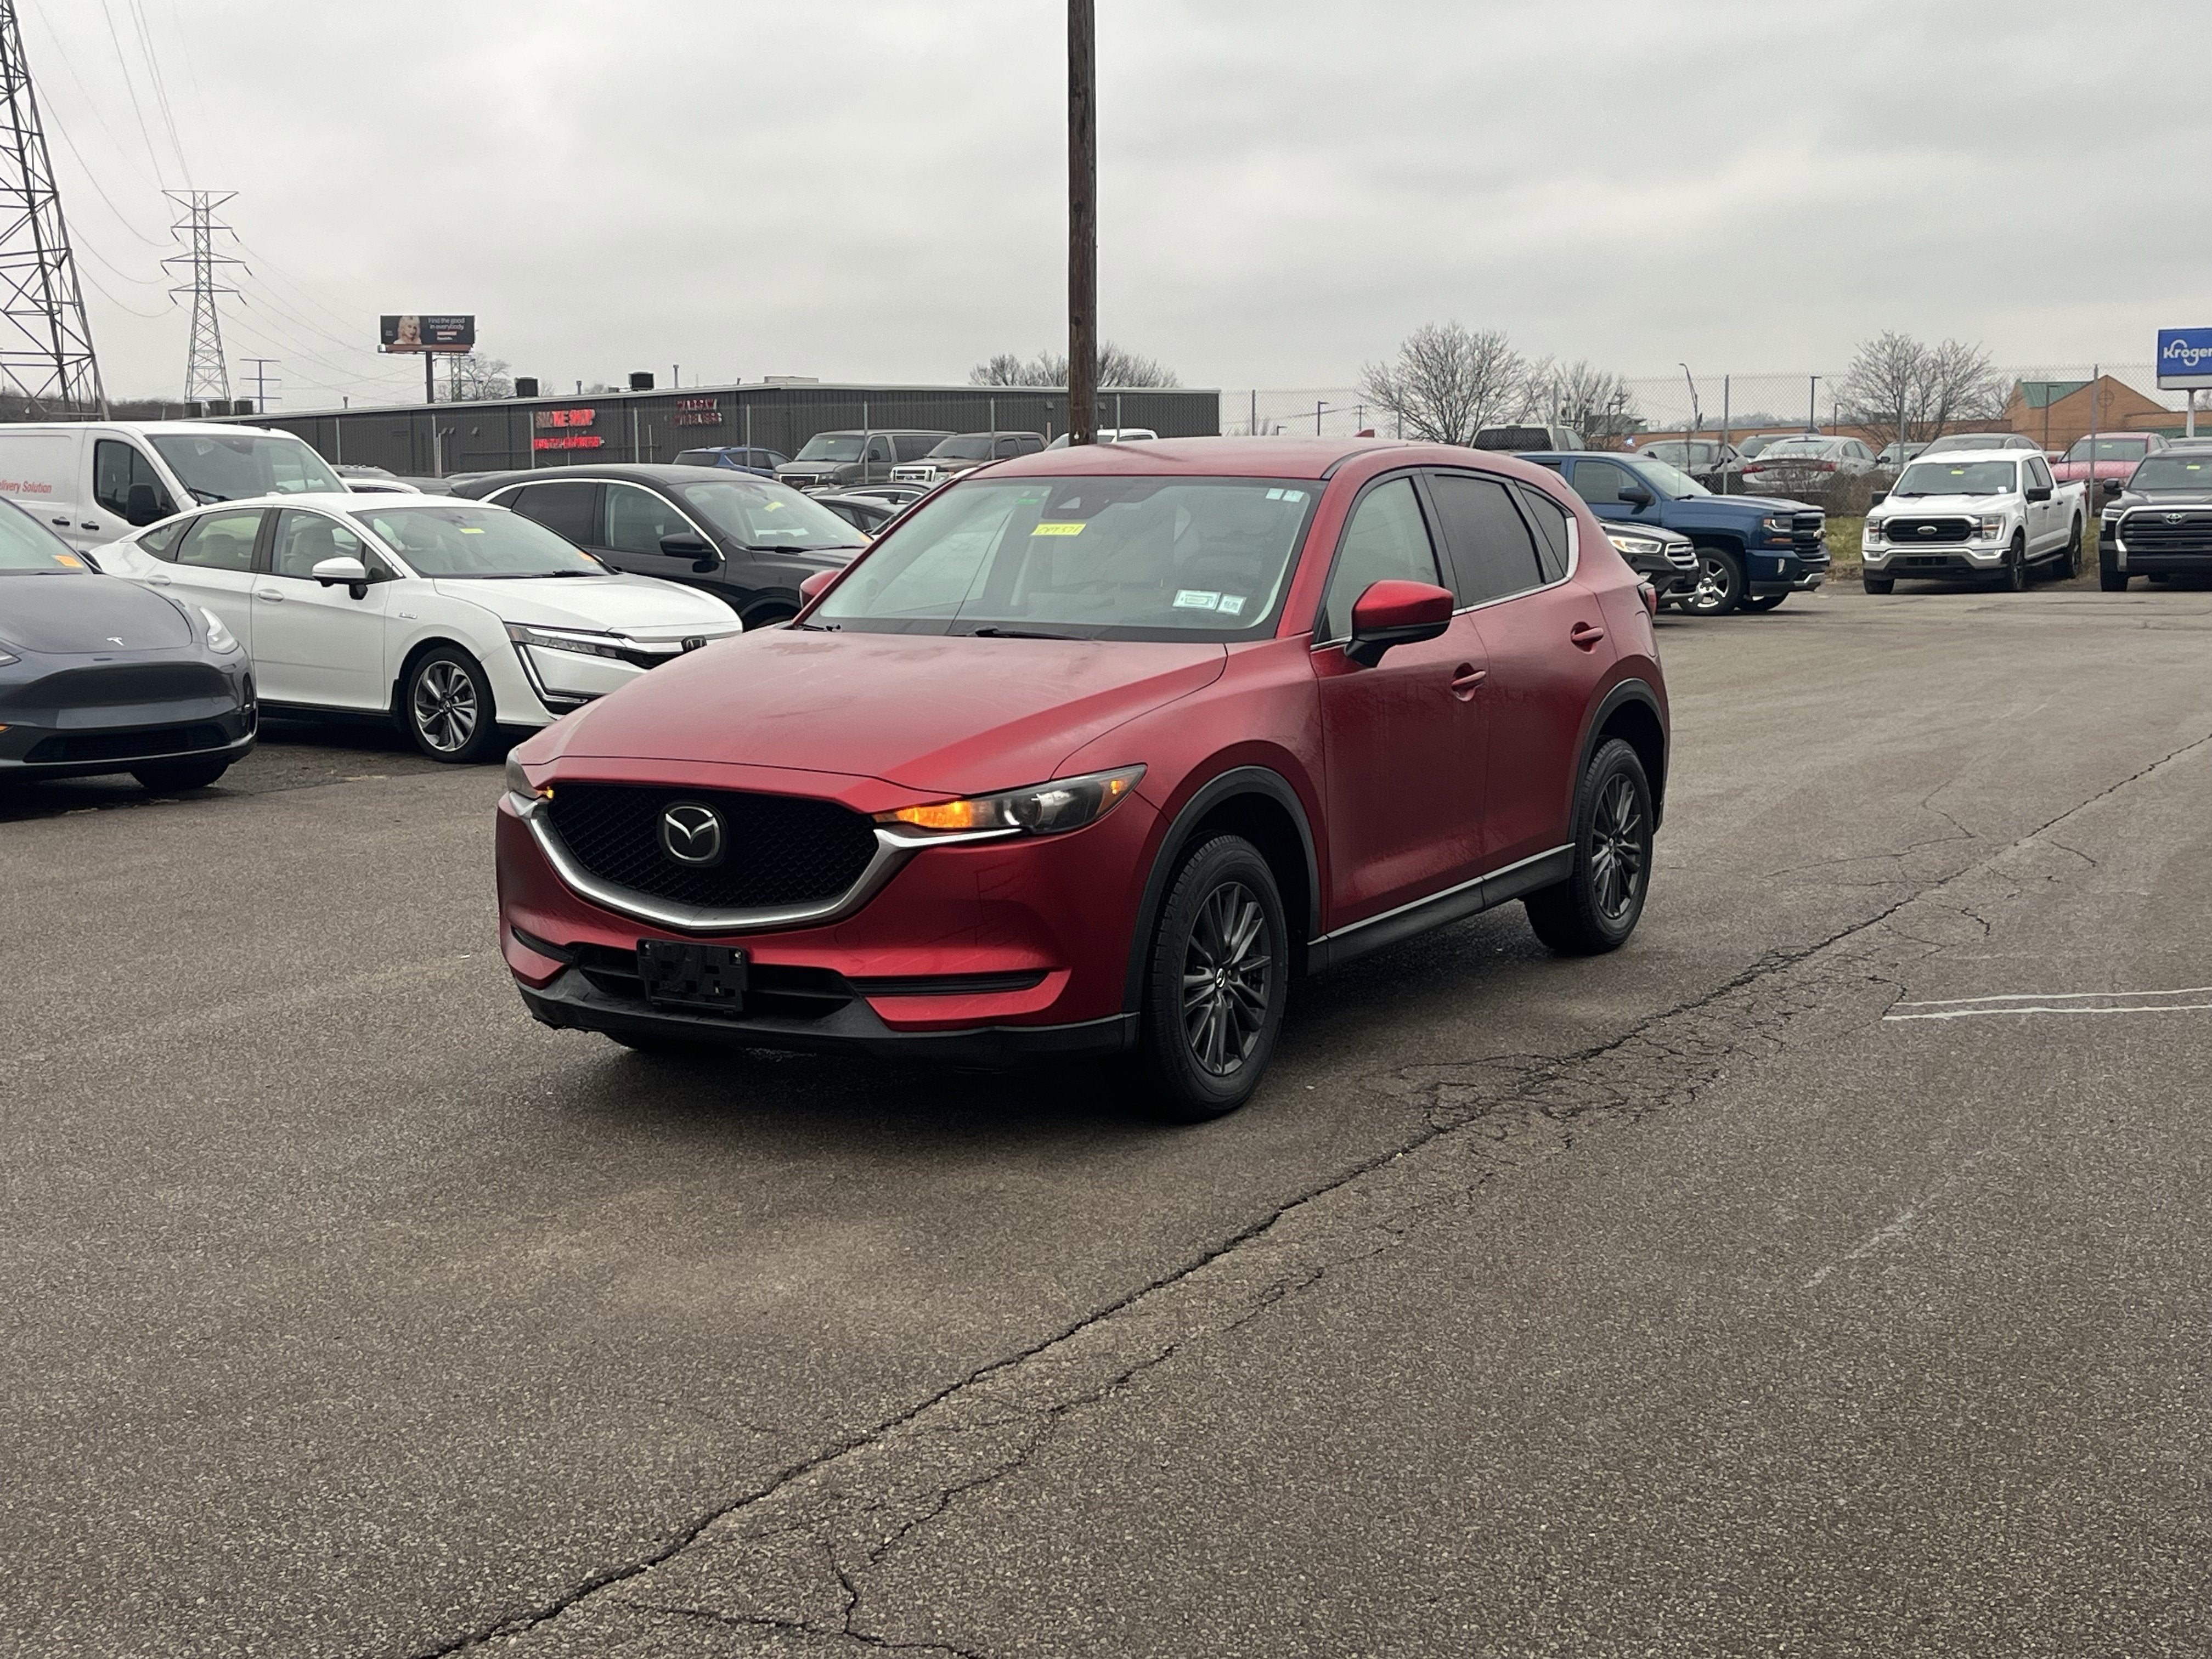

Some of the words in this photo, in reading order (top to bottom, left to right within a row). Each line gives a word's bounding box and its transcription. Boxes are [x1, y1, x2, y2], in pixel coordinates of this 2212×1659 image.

[2163, 339, 2212, 366] Kroger
[569, 409, 595, 427] SHOP
[22, 481, 52, 493] Solution
